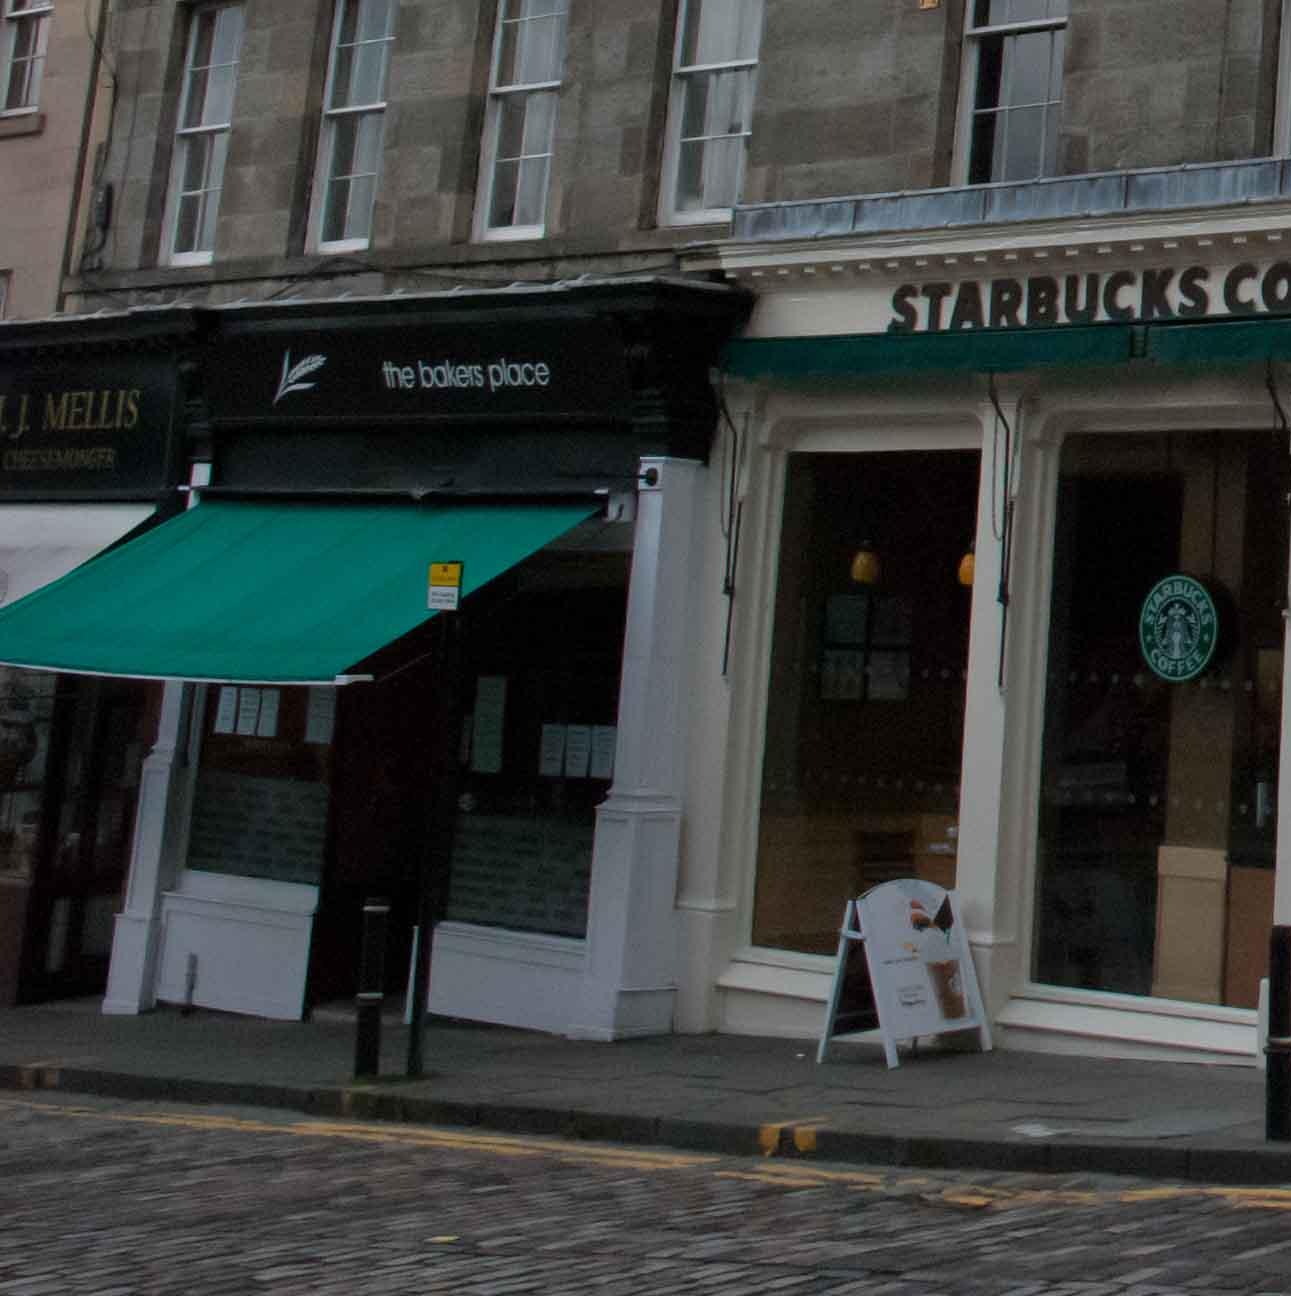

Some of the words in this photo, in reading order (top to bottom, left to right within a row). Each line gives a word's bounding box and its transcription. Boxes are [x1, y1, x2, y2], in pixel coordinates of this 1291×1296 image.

[891, 263, 1210, 332] STARBUCKS
[382, 361, 416, 389] the
[418, 359, 485, 389] bakers
[487, 357, 551, 392] place
[41, 388, 142, 432] MELLIS
[1143, 580, 1213, 625] STARBUCKS
[1151, 648, 1204, 676] COFFEE
